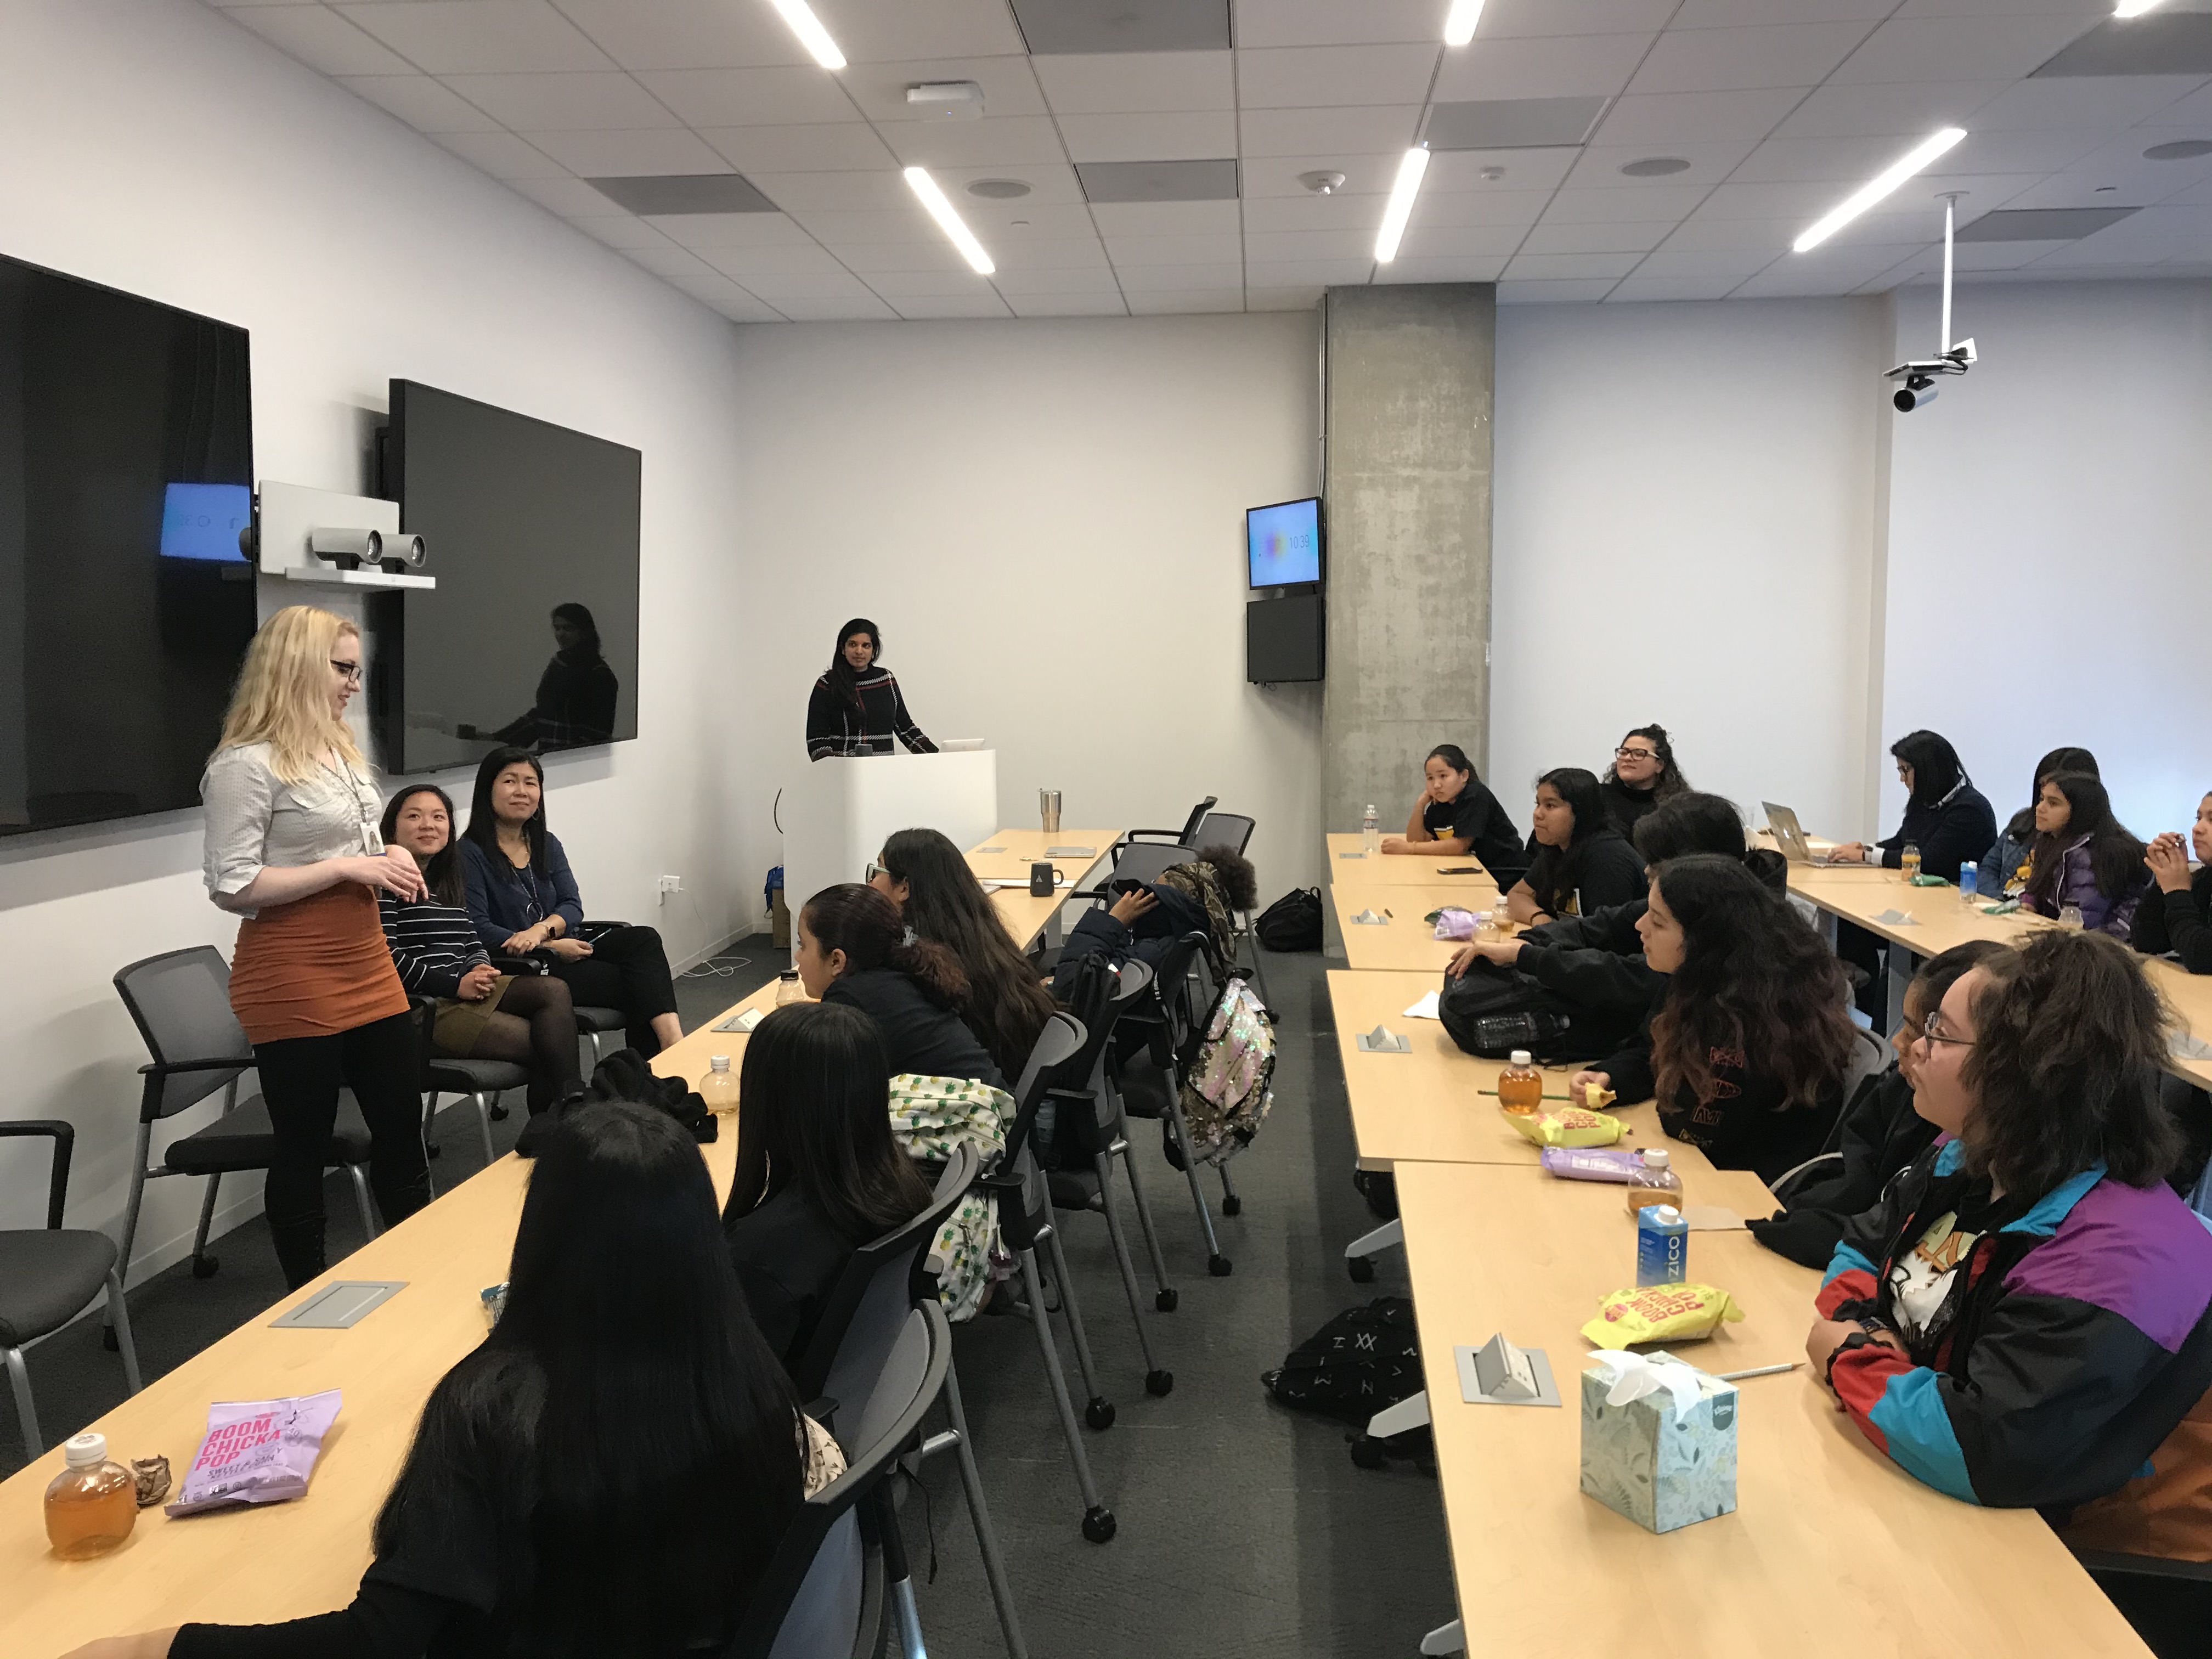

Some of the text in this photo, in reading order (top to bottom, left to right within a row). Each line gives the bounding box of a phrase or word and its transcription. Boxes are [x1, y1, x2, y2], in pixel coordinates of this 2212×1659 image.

[1668, 1236, 1680, 1277] ZICO
[1626, 1297, 1668, 1323] BOOM
[201, 1429, 281, 1457] CHICKA
[207, 1418, 271, 1443] BOOM
[195, 1451, 240, 1471] POP
